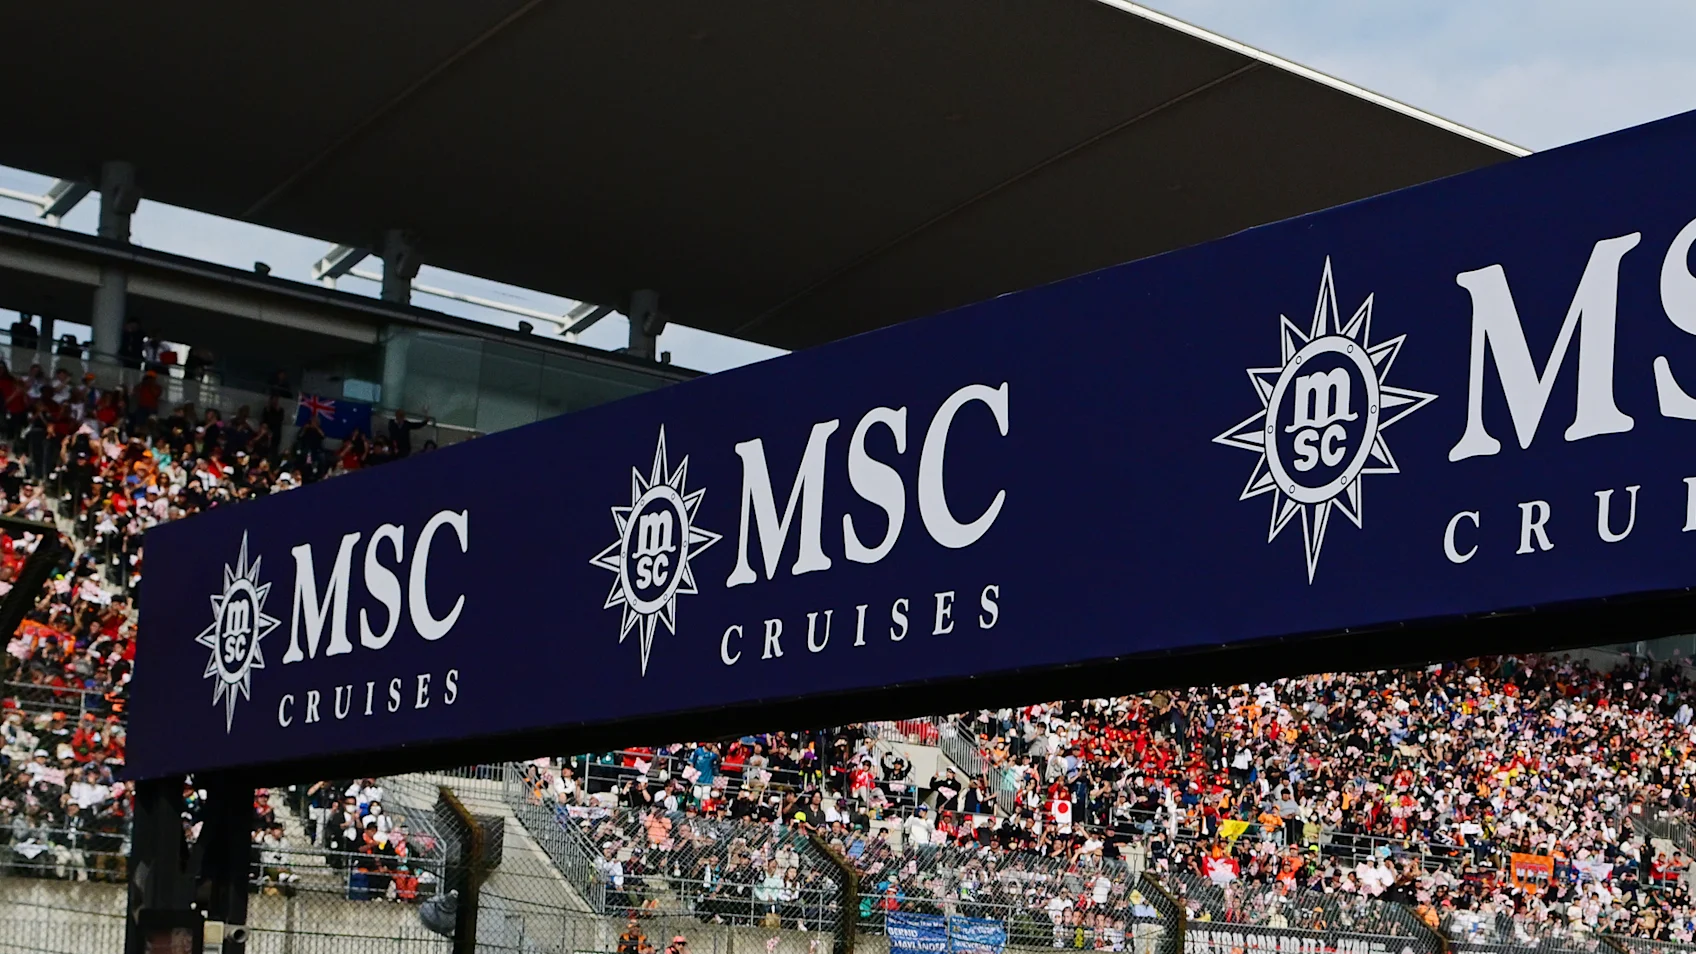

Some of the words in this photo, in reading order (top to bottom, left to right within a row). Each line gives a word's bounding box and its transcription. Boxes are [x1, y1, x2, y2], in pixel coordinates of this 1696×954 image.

[726, 382, 1008, 590] MSC
[280, 510, 468, 664] MSC
[721, 582, 999, 665] CRUISES
[279, 670, 458, 727] CRUISES
